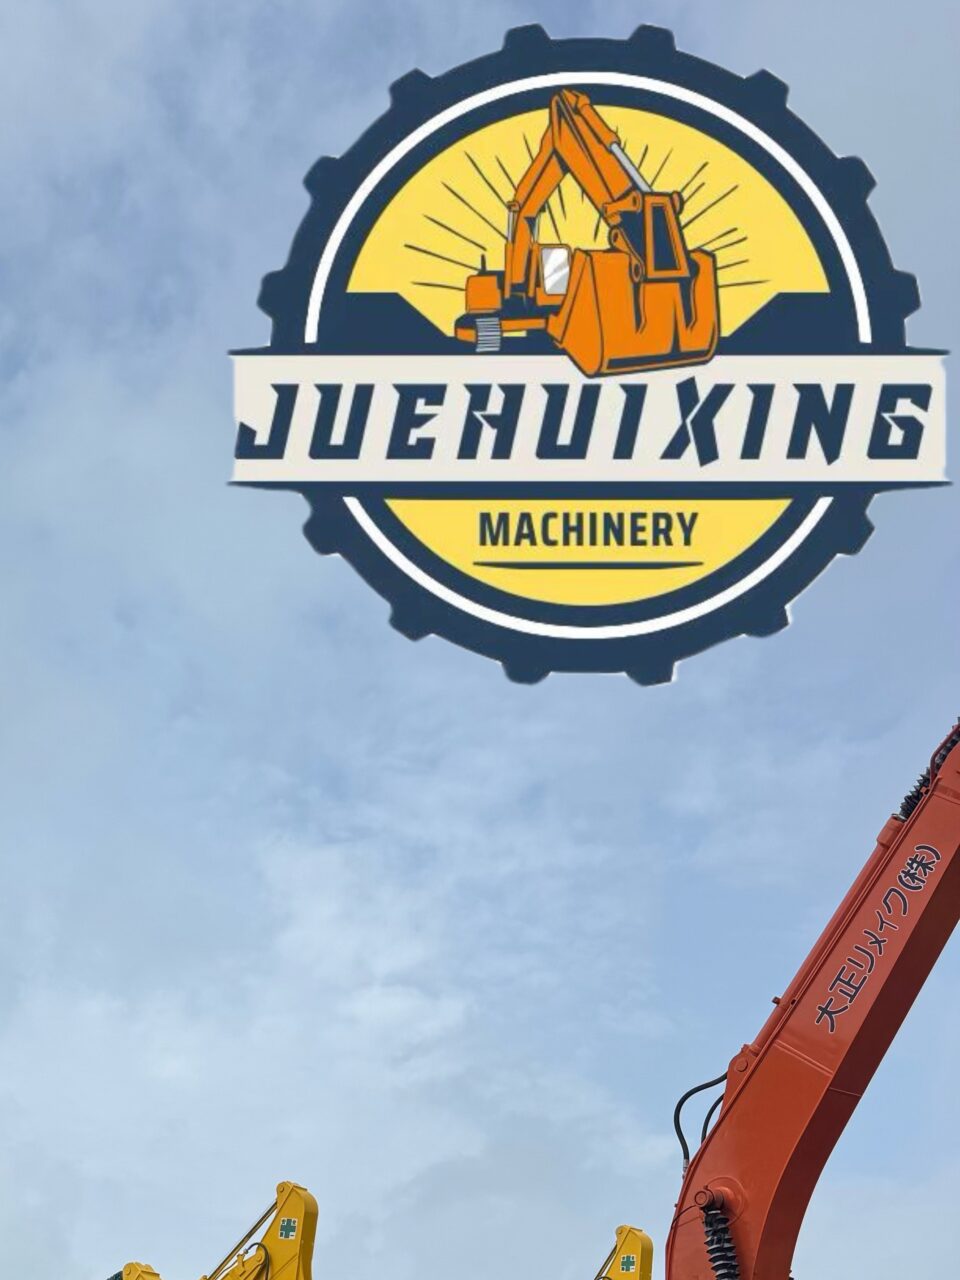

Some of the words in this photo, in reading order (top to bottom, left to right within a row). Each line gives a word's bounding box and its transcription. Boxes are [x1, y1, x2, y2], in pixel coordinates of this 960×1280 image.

[815, 844, 942, 1034] 大正リメイク(株)
